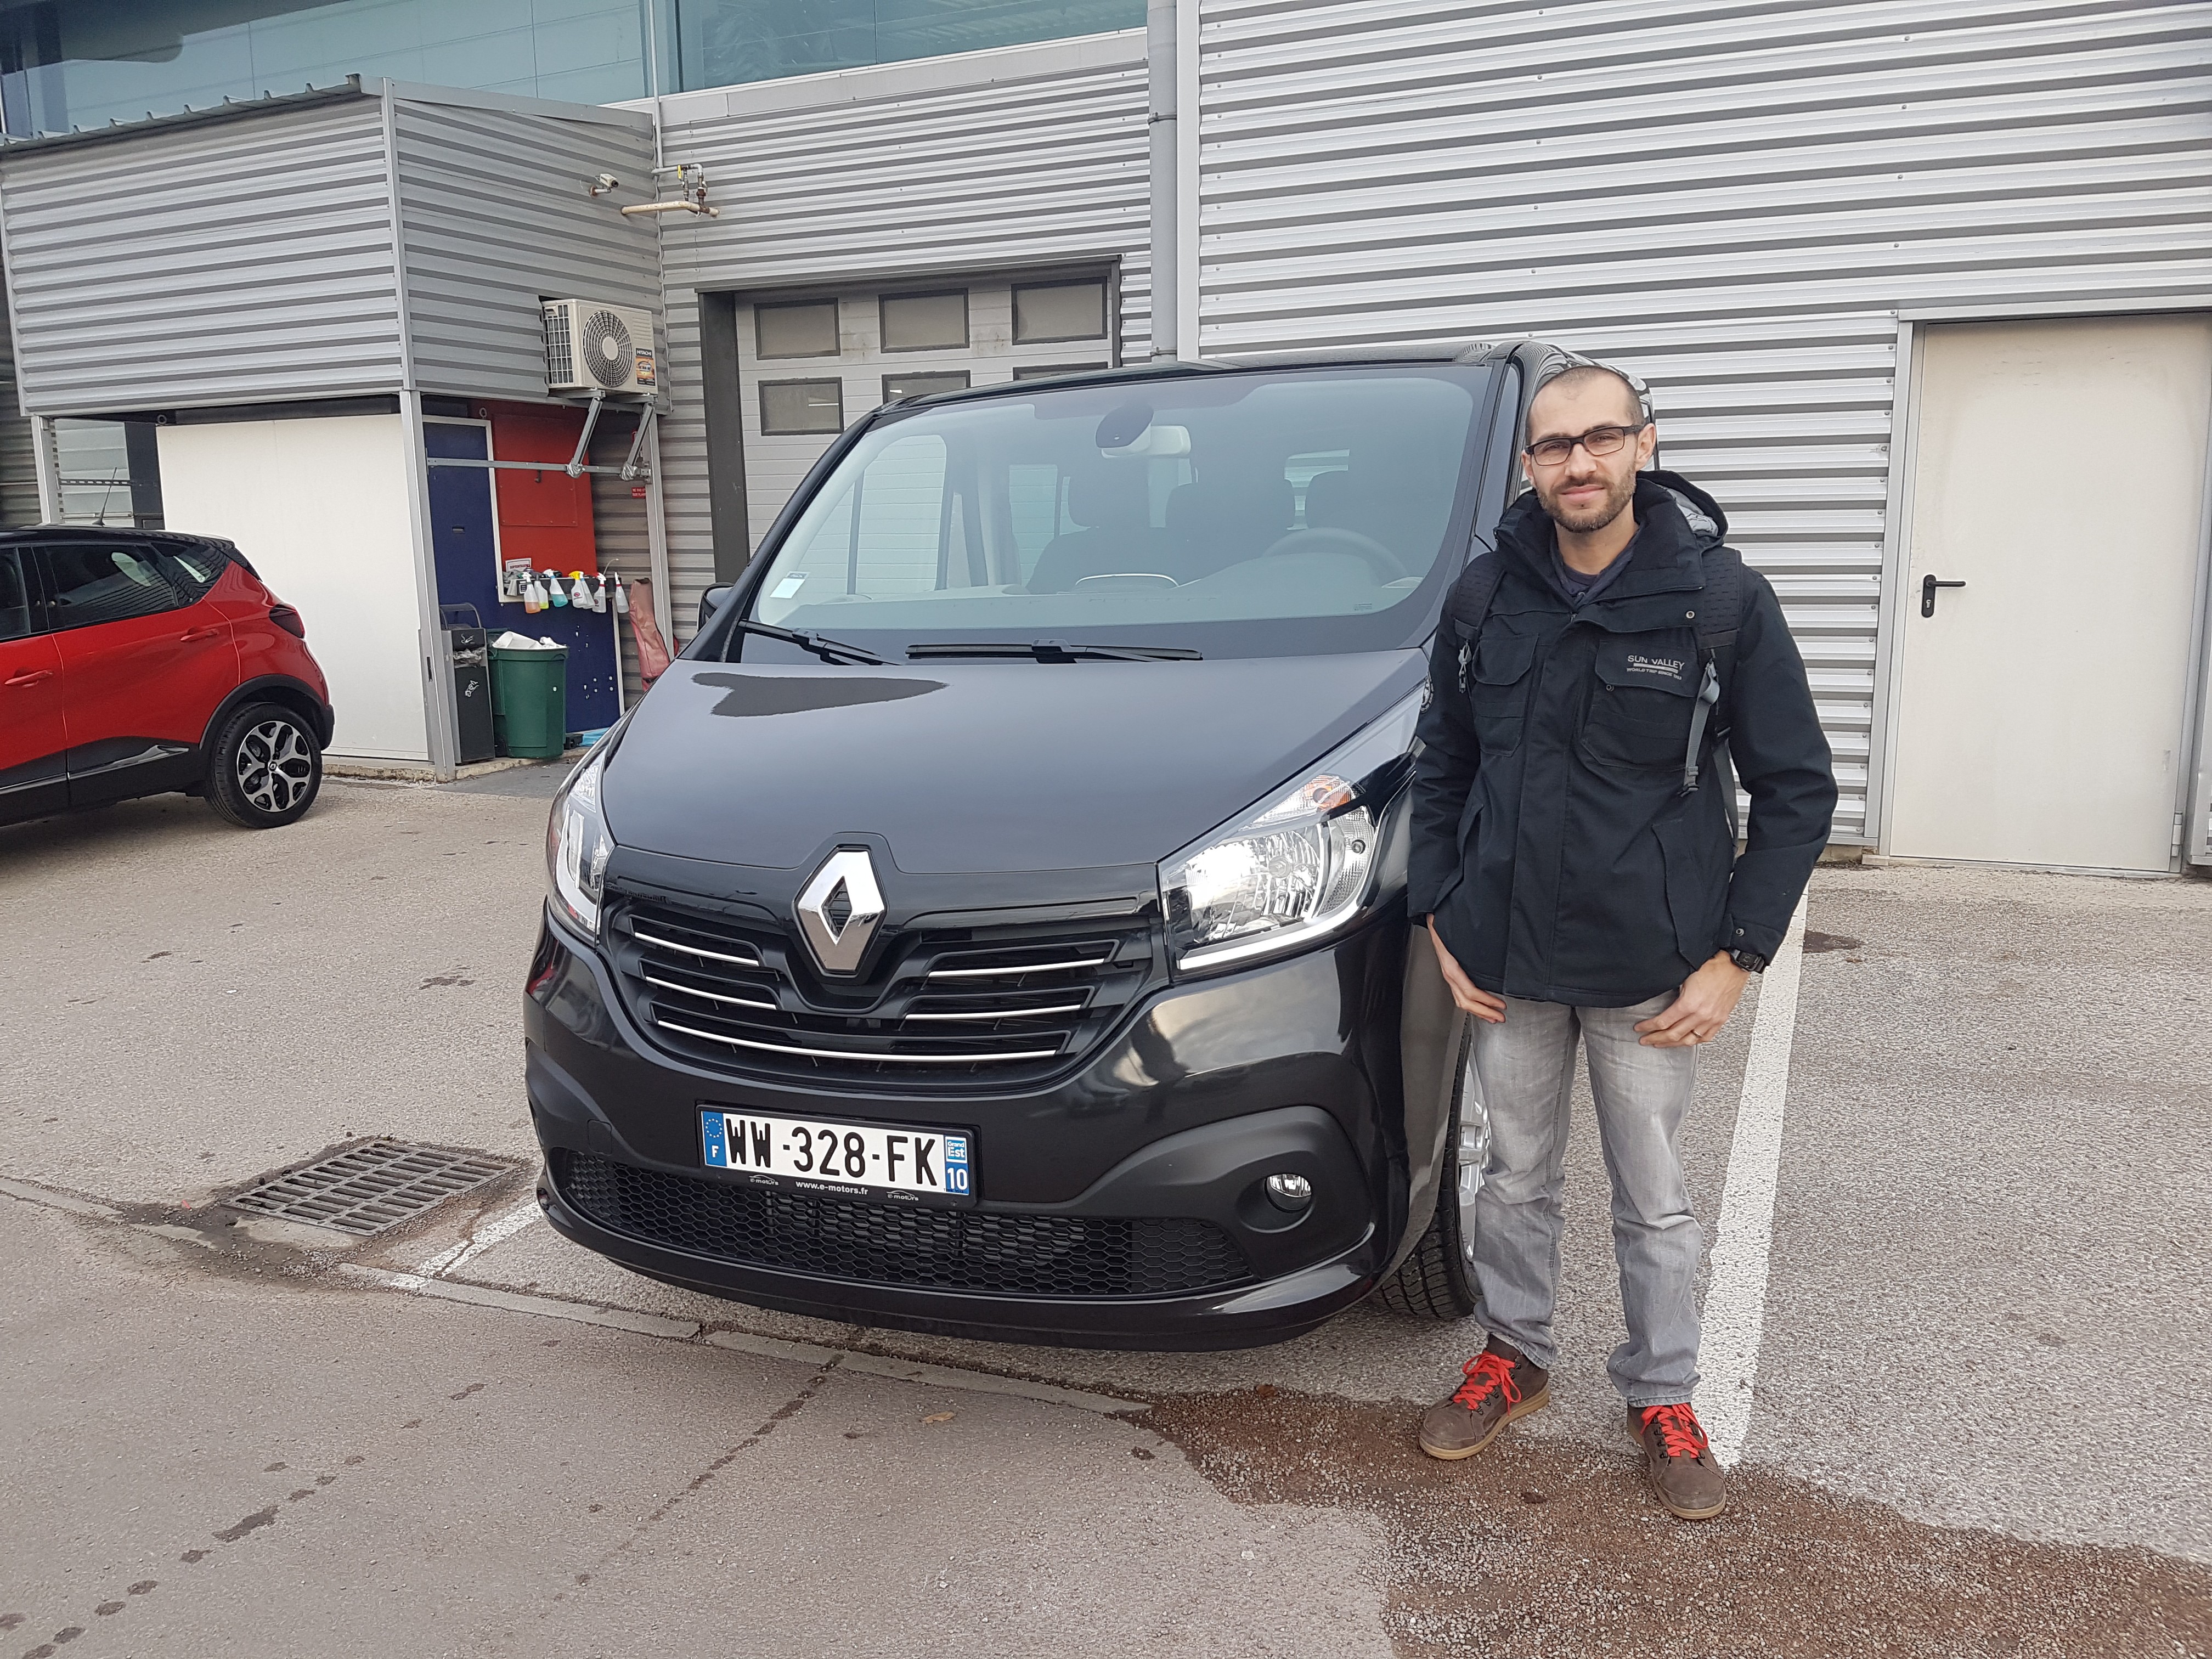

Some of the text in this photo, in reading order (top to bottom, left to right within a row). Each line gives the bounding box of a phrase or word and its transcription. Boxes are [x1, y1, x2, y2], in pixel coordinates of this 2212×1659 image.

[1627, 654, 1685, 670] SUN VALLEY
[712, 1145, 719, 1158] F
[947, 1147, 965, 1158] Est
[947, 1167, 968, 1190] 10
[795, 1181, 868, 1195] www.e-motors.fr
